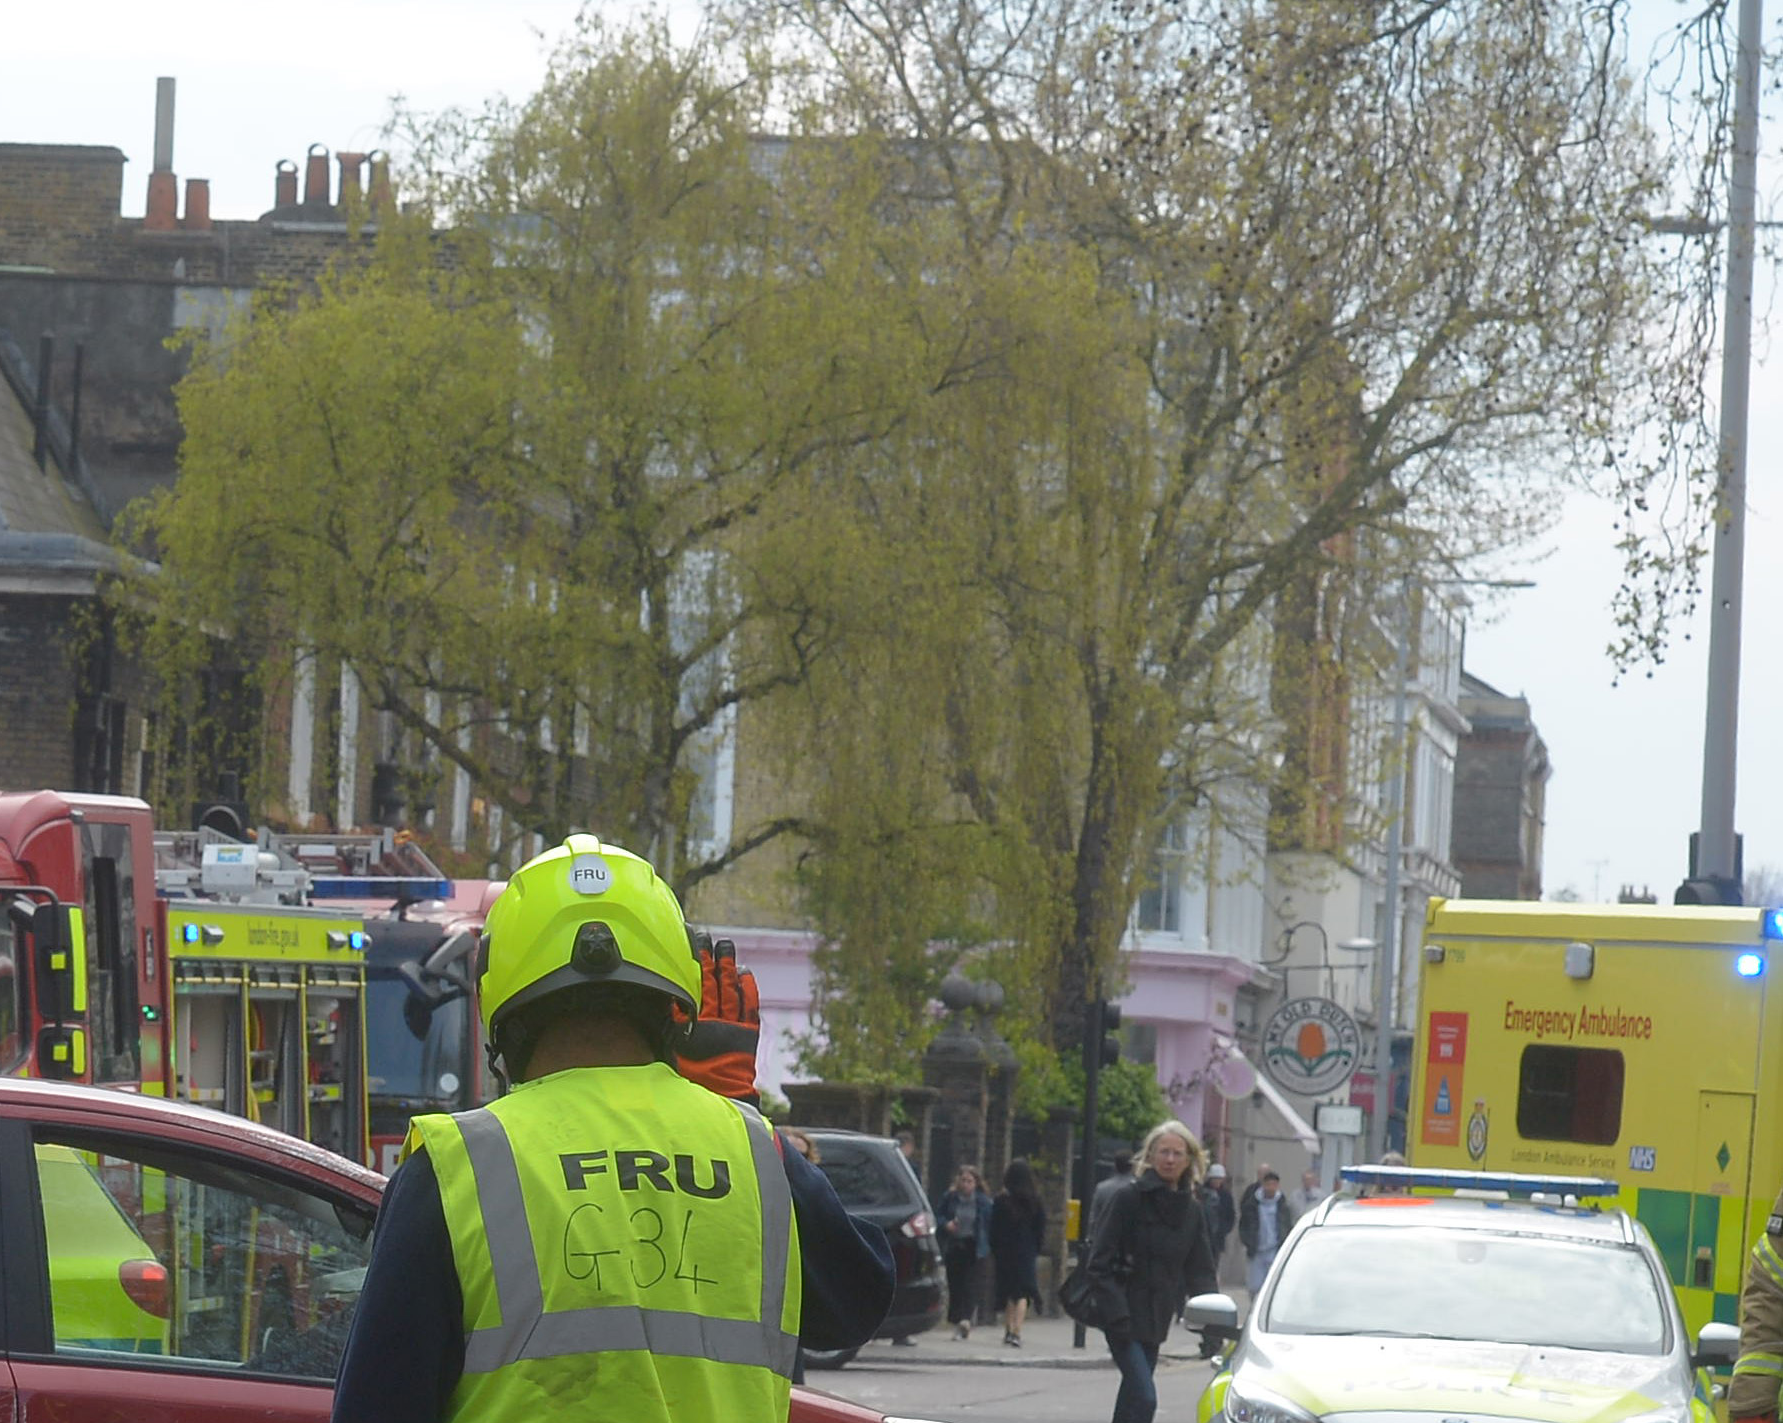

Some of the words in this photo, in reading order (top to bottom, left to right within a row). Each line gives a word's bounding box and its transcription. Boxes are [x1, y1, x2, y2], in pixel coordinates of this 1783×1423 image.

[574, 869, 606, 882] FRU
[1505, 1000, 1577, 1040] Emergency
[1578, 1004, 1652, 1040] Ambulance
[1511, 1148, 1542, 1163] London
[1543, 1150, 1587, 1167] Ambulance
[1588, 1153, 1616, 1170] Service
[1632, 1148, 1655, 1171] NHS
[559, 1149, 732, 1199] FRU
